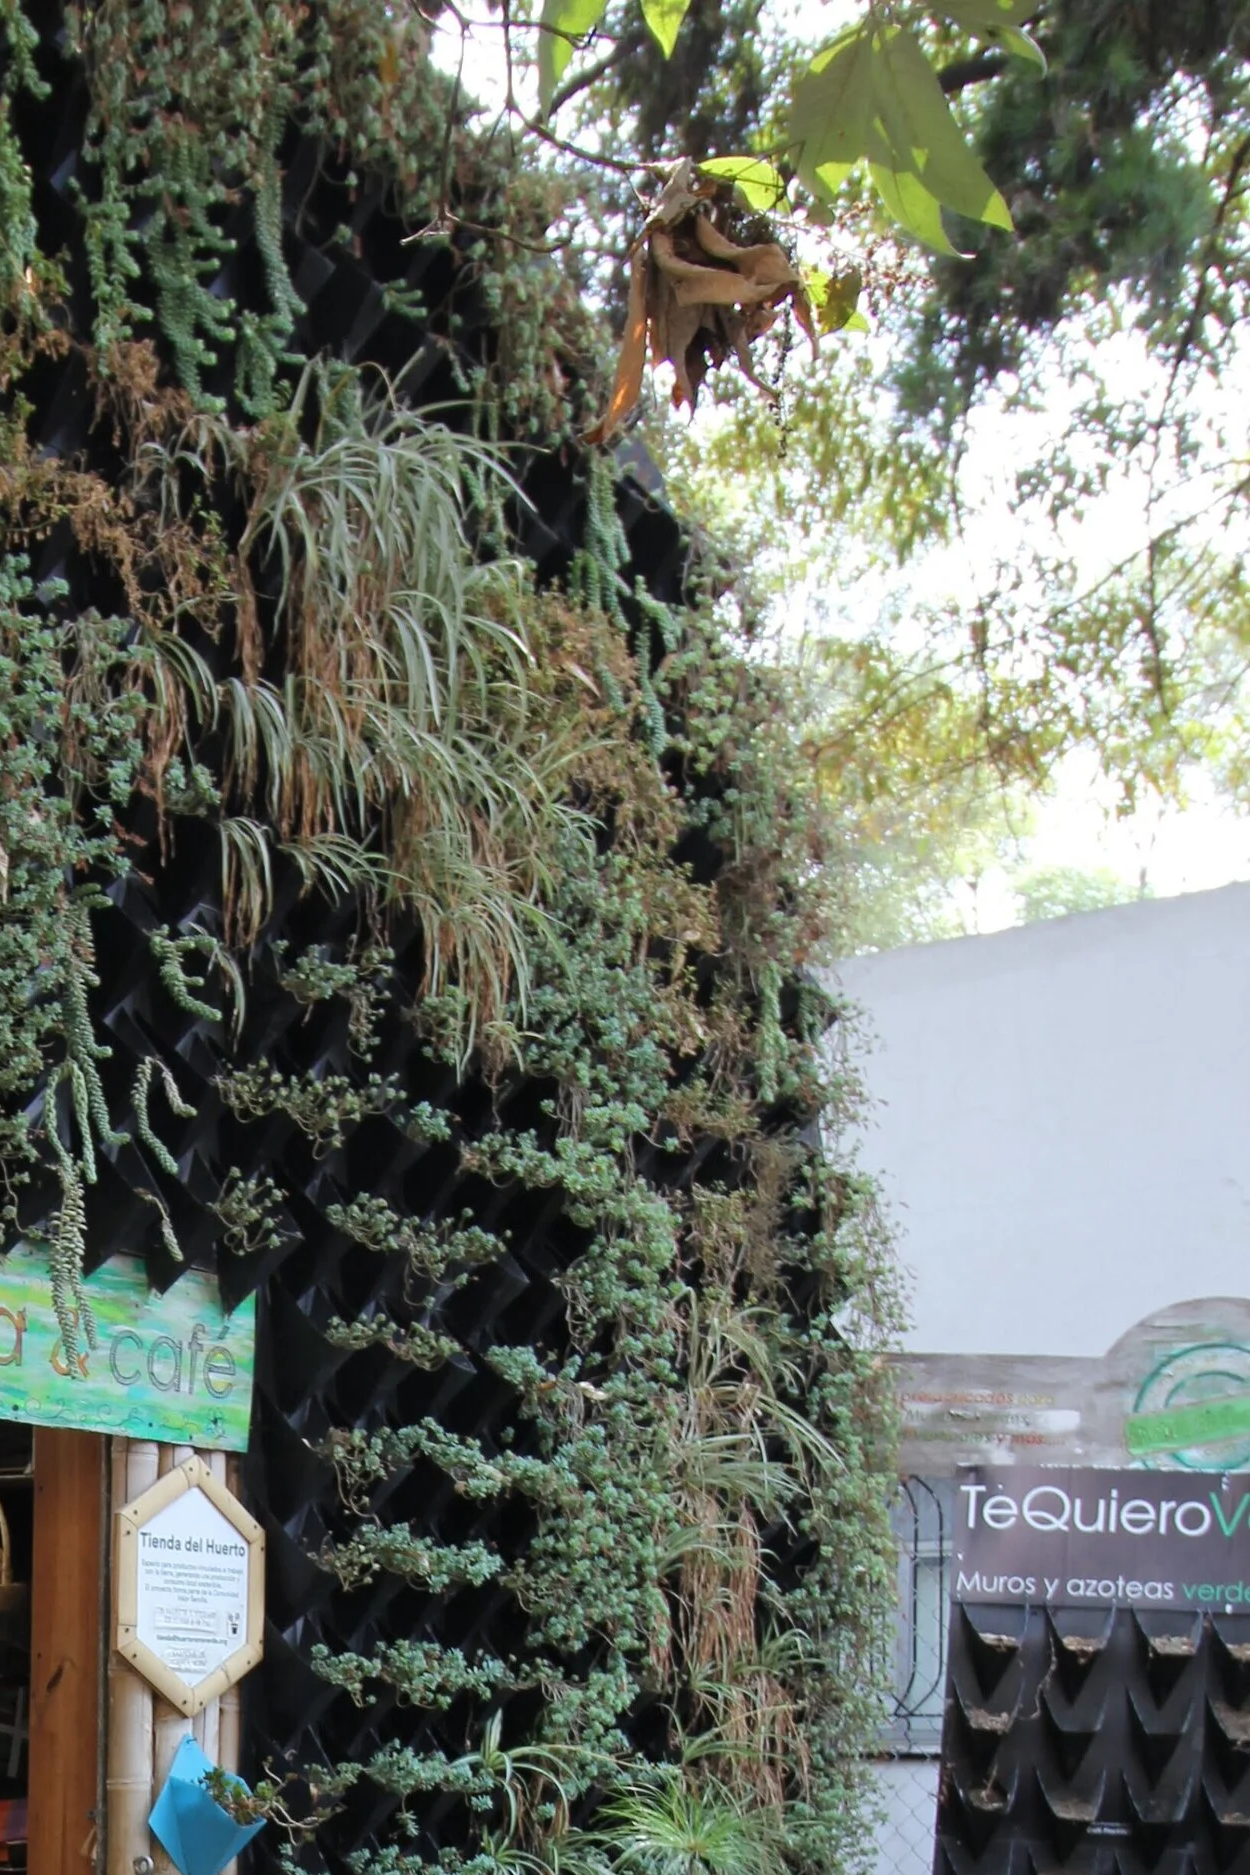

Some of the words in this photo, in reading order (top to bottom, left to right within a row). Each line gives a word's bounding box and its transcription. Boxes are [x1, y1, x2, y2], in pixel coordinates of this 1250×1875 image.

[109, 1322, 236, 1400] café
[960, 1485, 1250, 1538] TeQuieroV
[140, 1532, 181, 1551] Tienda
[185, 1535, 203, 1553] del
[206, 1538, 246, 1558] Huerto
[956, 1571, 1036, 1595] Muros
[1044, 1577, 1059, 1598] y
[1067, 1576, 1174, 1600] azoteas
